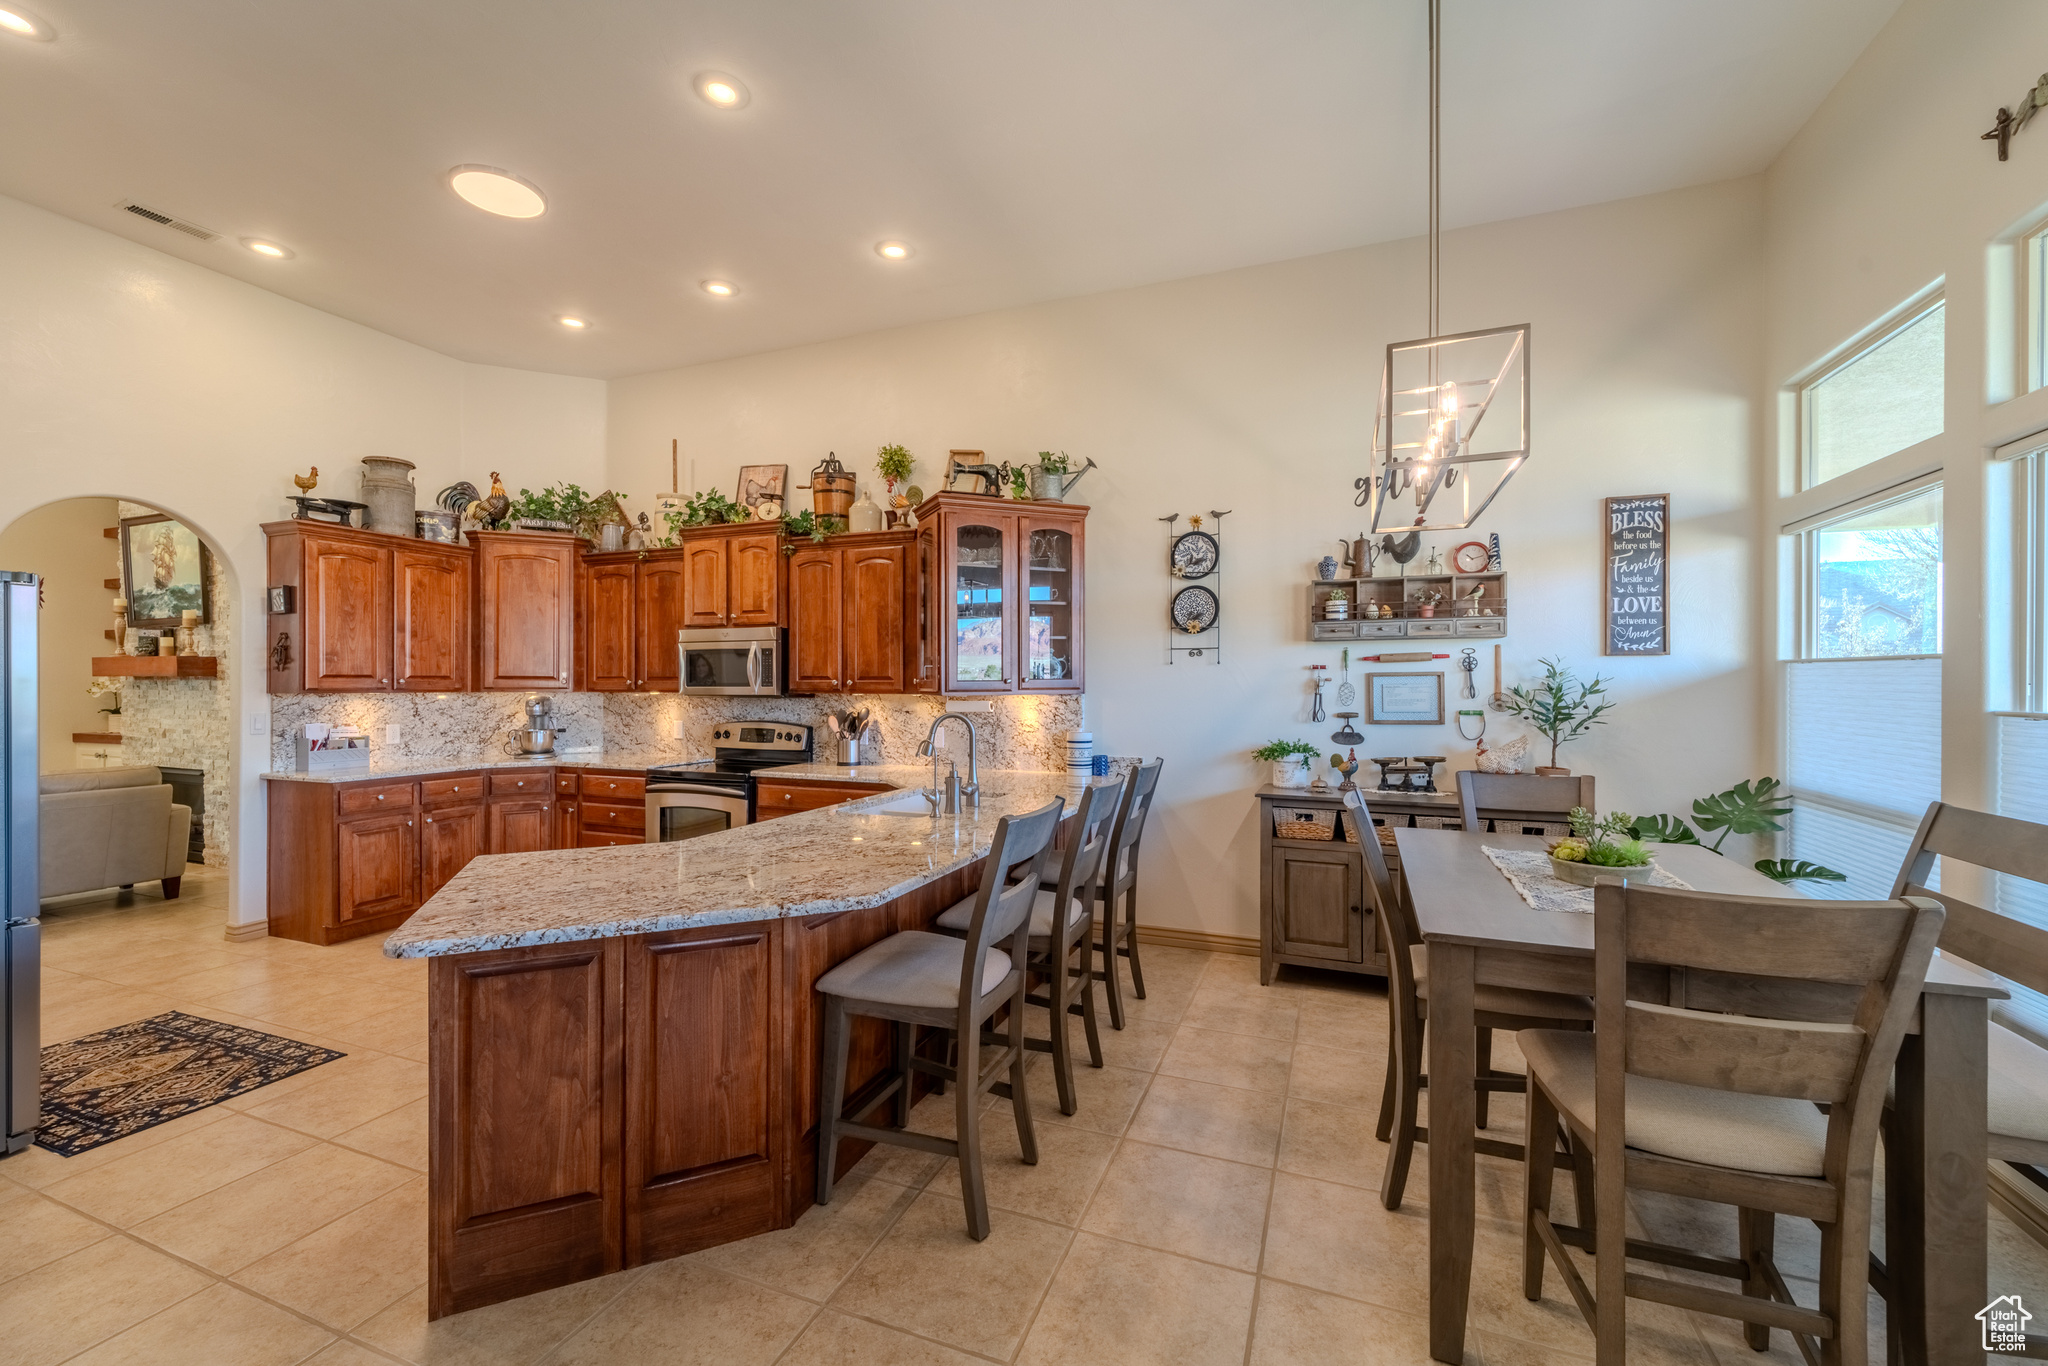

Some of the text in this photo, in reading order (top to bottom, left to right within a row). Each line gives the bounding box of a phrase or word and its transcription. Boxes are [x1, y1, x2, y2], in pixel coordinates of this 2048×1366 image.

[521, 518, 572, 529] FARM FRESH
[1611, 510, 1663, 534] BLESS
[1622, 529, 1652, 539] the food
[1614, 540, 1662, 551] before us the
[1610, 550, 1665, 581] Family
[1621, 574, 1643, 583] beside
[1626, 584, 1649, 593] & the
[1612, 596, 1663, 614] LOVE
[1617, 616, 1658, 625] between us
[1613, 626, 1657, 640] Amen
